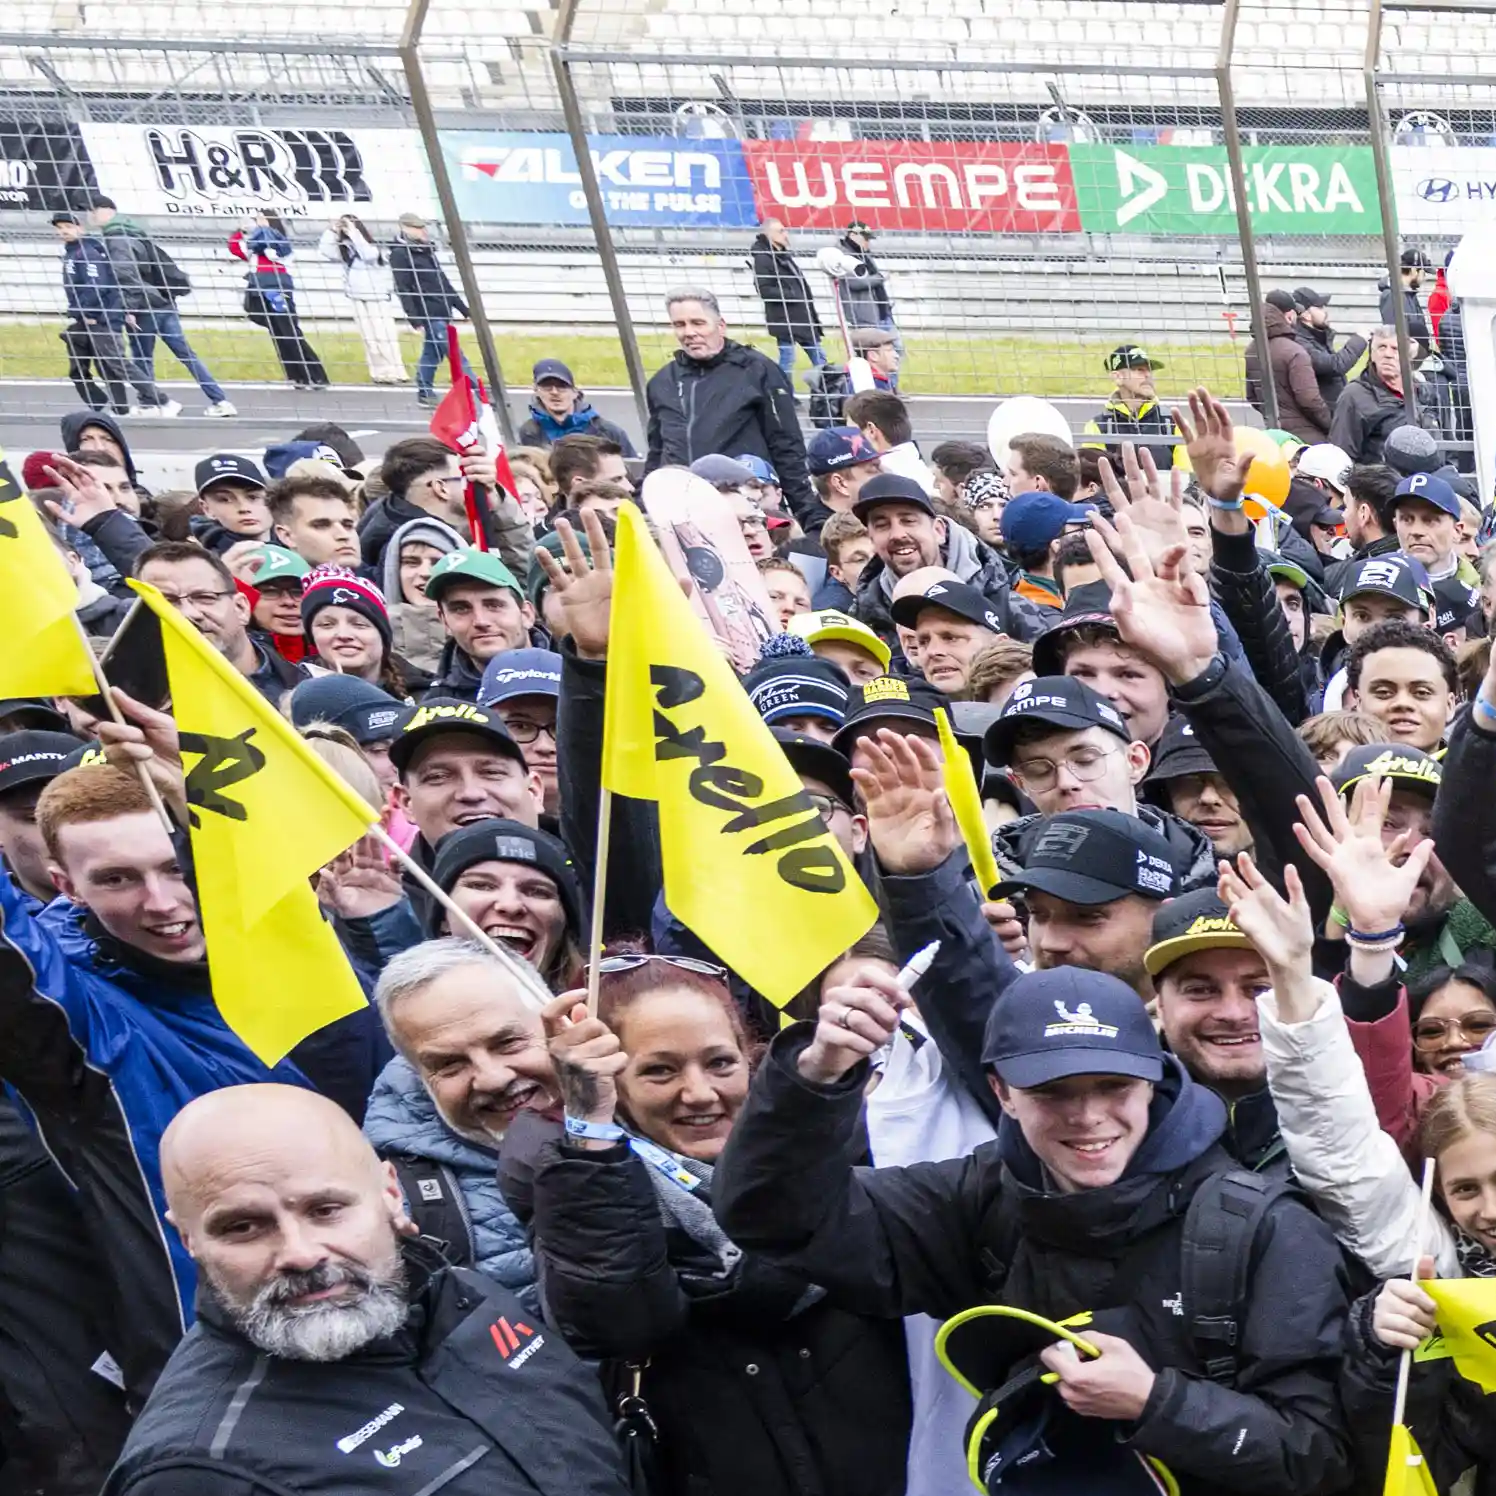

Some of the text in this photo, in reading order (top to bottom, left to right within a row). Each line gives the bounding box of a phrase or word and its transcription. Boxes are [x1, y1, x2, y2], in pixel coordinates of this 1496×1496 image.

[147, 128, 296, 200] H&R
[459, 146, 721, 189] FALKEN
[766, 160, 1061, 211] WEMPE
[166, 202, 205, 216] Das
[496, 666, 562, 683] TaylorM
[760, 693, 799, 711] GREEN
